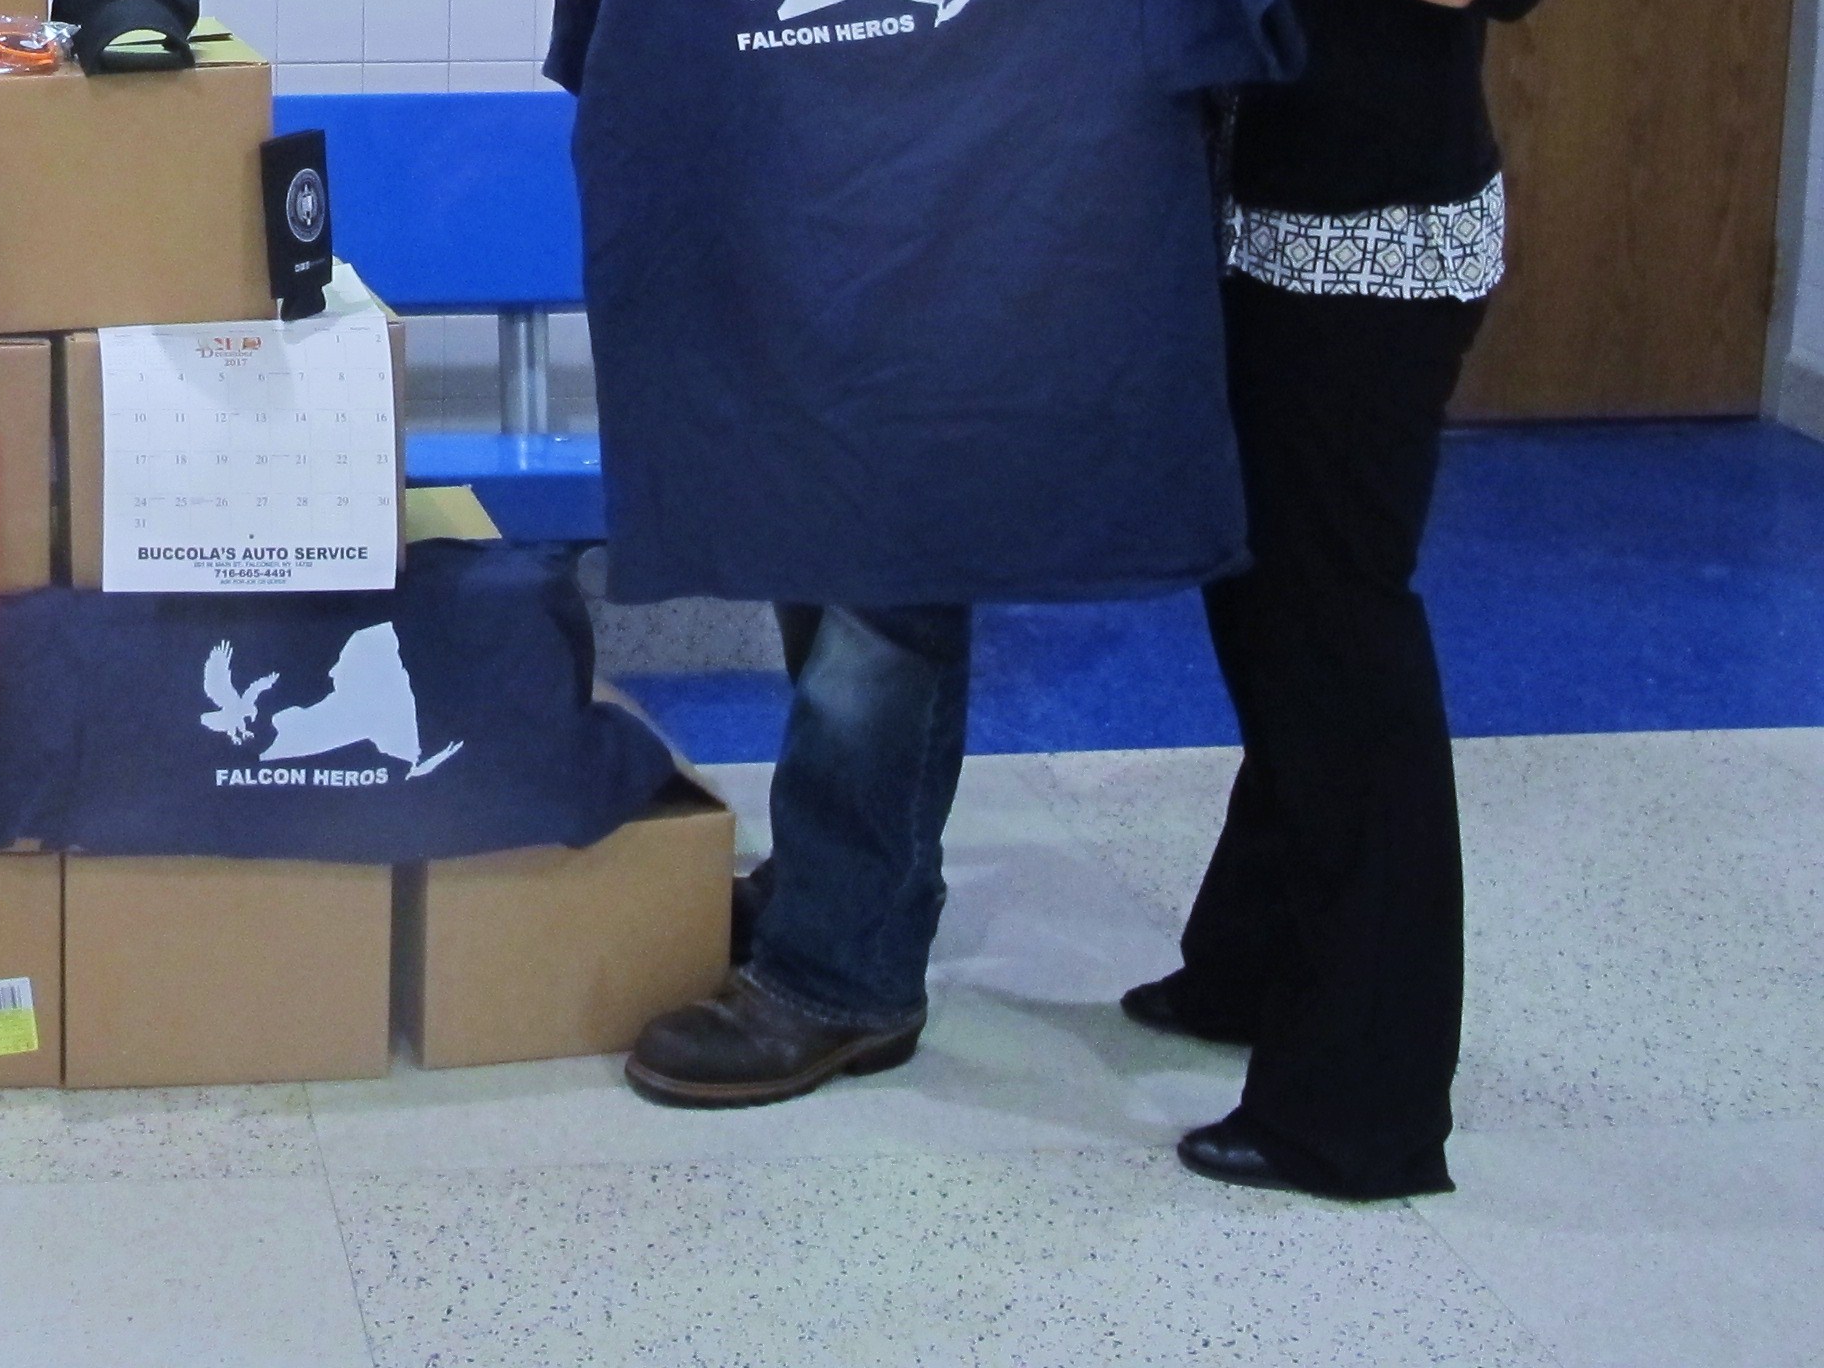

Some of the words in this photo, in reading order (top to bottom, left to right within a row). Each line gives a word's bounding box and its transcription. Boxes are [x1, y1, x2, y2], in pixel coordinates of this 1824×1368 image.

[737, 25, 830, 50] FALCON
[835, 15, 915, 42] HEROS
[335, 335, 341, 343] 1
[376, 335, 381, 343] 2
[138, 373, 145, 382] 3
[178, 373, 184, 381] 4
[218, 373, 225, 382] 5
[258, 373, 265, 381] 6
[298, 373, 304, 381] 7
[338, 373, 345, 381] 8
[379, 373, 385, 381] 9
[134, 413, 146, 422] 10
[175, 413, 185, 422] 11
[215, 413, 227, 422] 12
[255, 413, 267, 422] 13
[295, 413, 307, 422] 14
[335, 413, 346, 422] 15
[376, 413, 387, 422] 16
[135, 455, 147, 464] 17
[176, 455, 187, 464] 18
[216, 455, 227, 464] 19
[256, 455, 268, 464] 20
[295, 455, 307, 464] 21
[336, 455, 347, 464] 22
[377, 455, 388, 464] 23
[134, 497, 147, 506] 24
[175, 497, 188, 506] 25
[216, 497, 228, 506] 26
[256, 497, 268, 506] 27
[296, 497, 308, 506] 28
[337, 497, 349, 506] 29
[378, 497, 389, 506] 30
[134, 519, 146, 528] 31
[138, 547, 236, 561] BUCCOLA'S
[242, 547, 288, 561] AUTO
[294, 547, 368, 560] SERVICE
[214, 569, 292, 578] 716-665-4491
[216, 768, 306, 786] FALCON
[312, 767, 388, 786] HEROS
